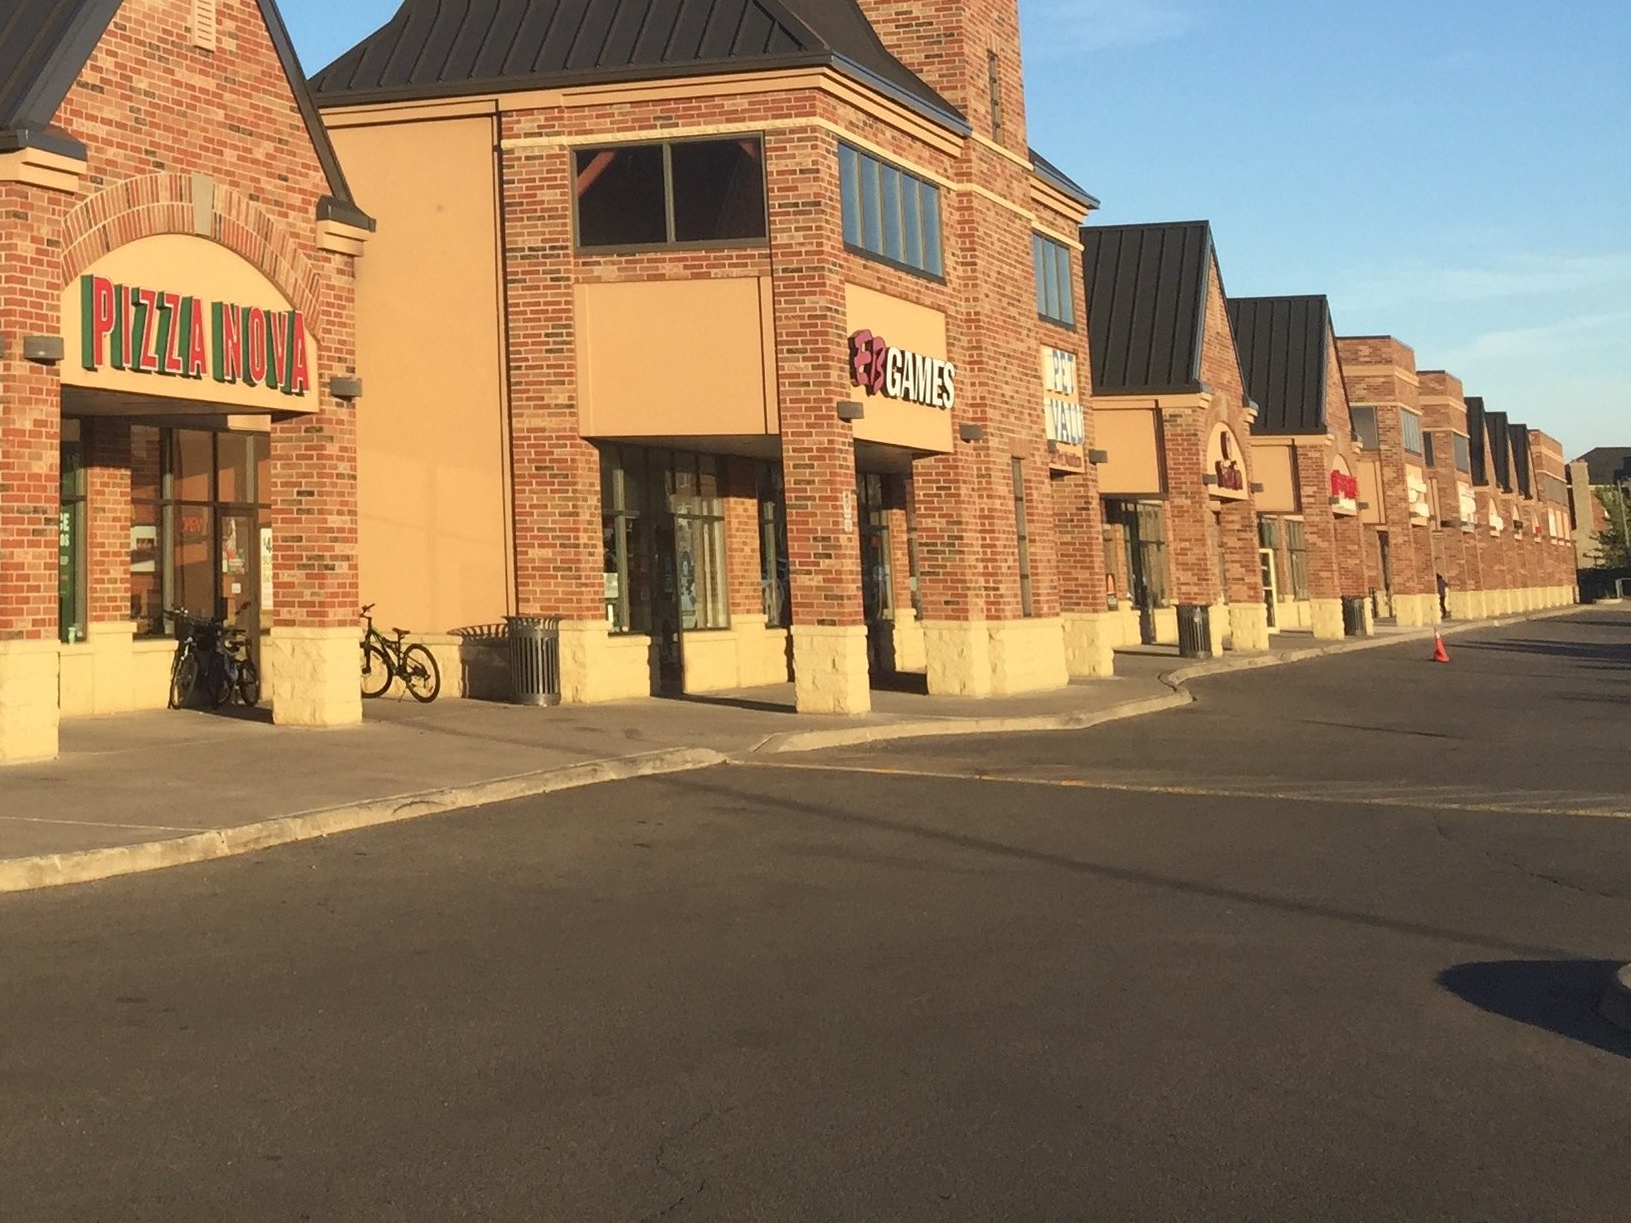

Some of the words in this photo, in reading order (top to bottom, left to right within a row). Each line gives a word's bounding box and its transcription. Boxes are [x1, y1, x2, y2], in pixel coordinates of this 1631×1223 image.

[80, 274, 208, 380] PIZZA
[211, 301, 310, 396] NOVA
[848, 329, 886, 396] EB
[885, 346, 956, 410] GAMES
[1047, 348, 1076, 395] PET
